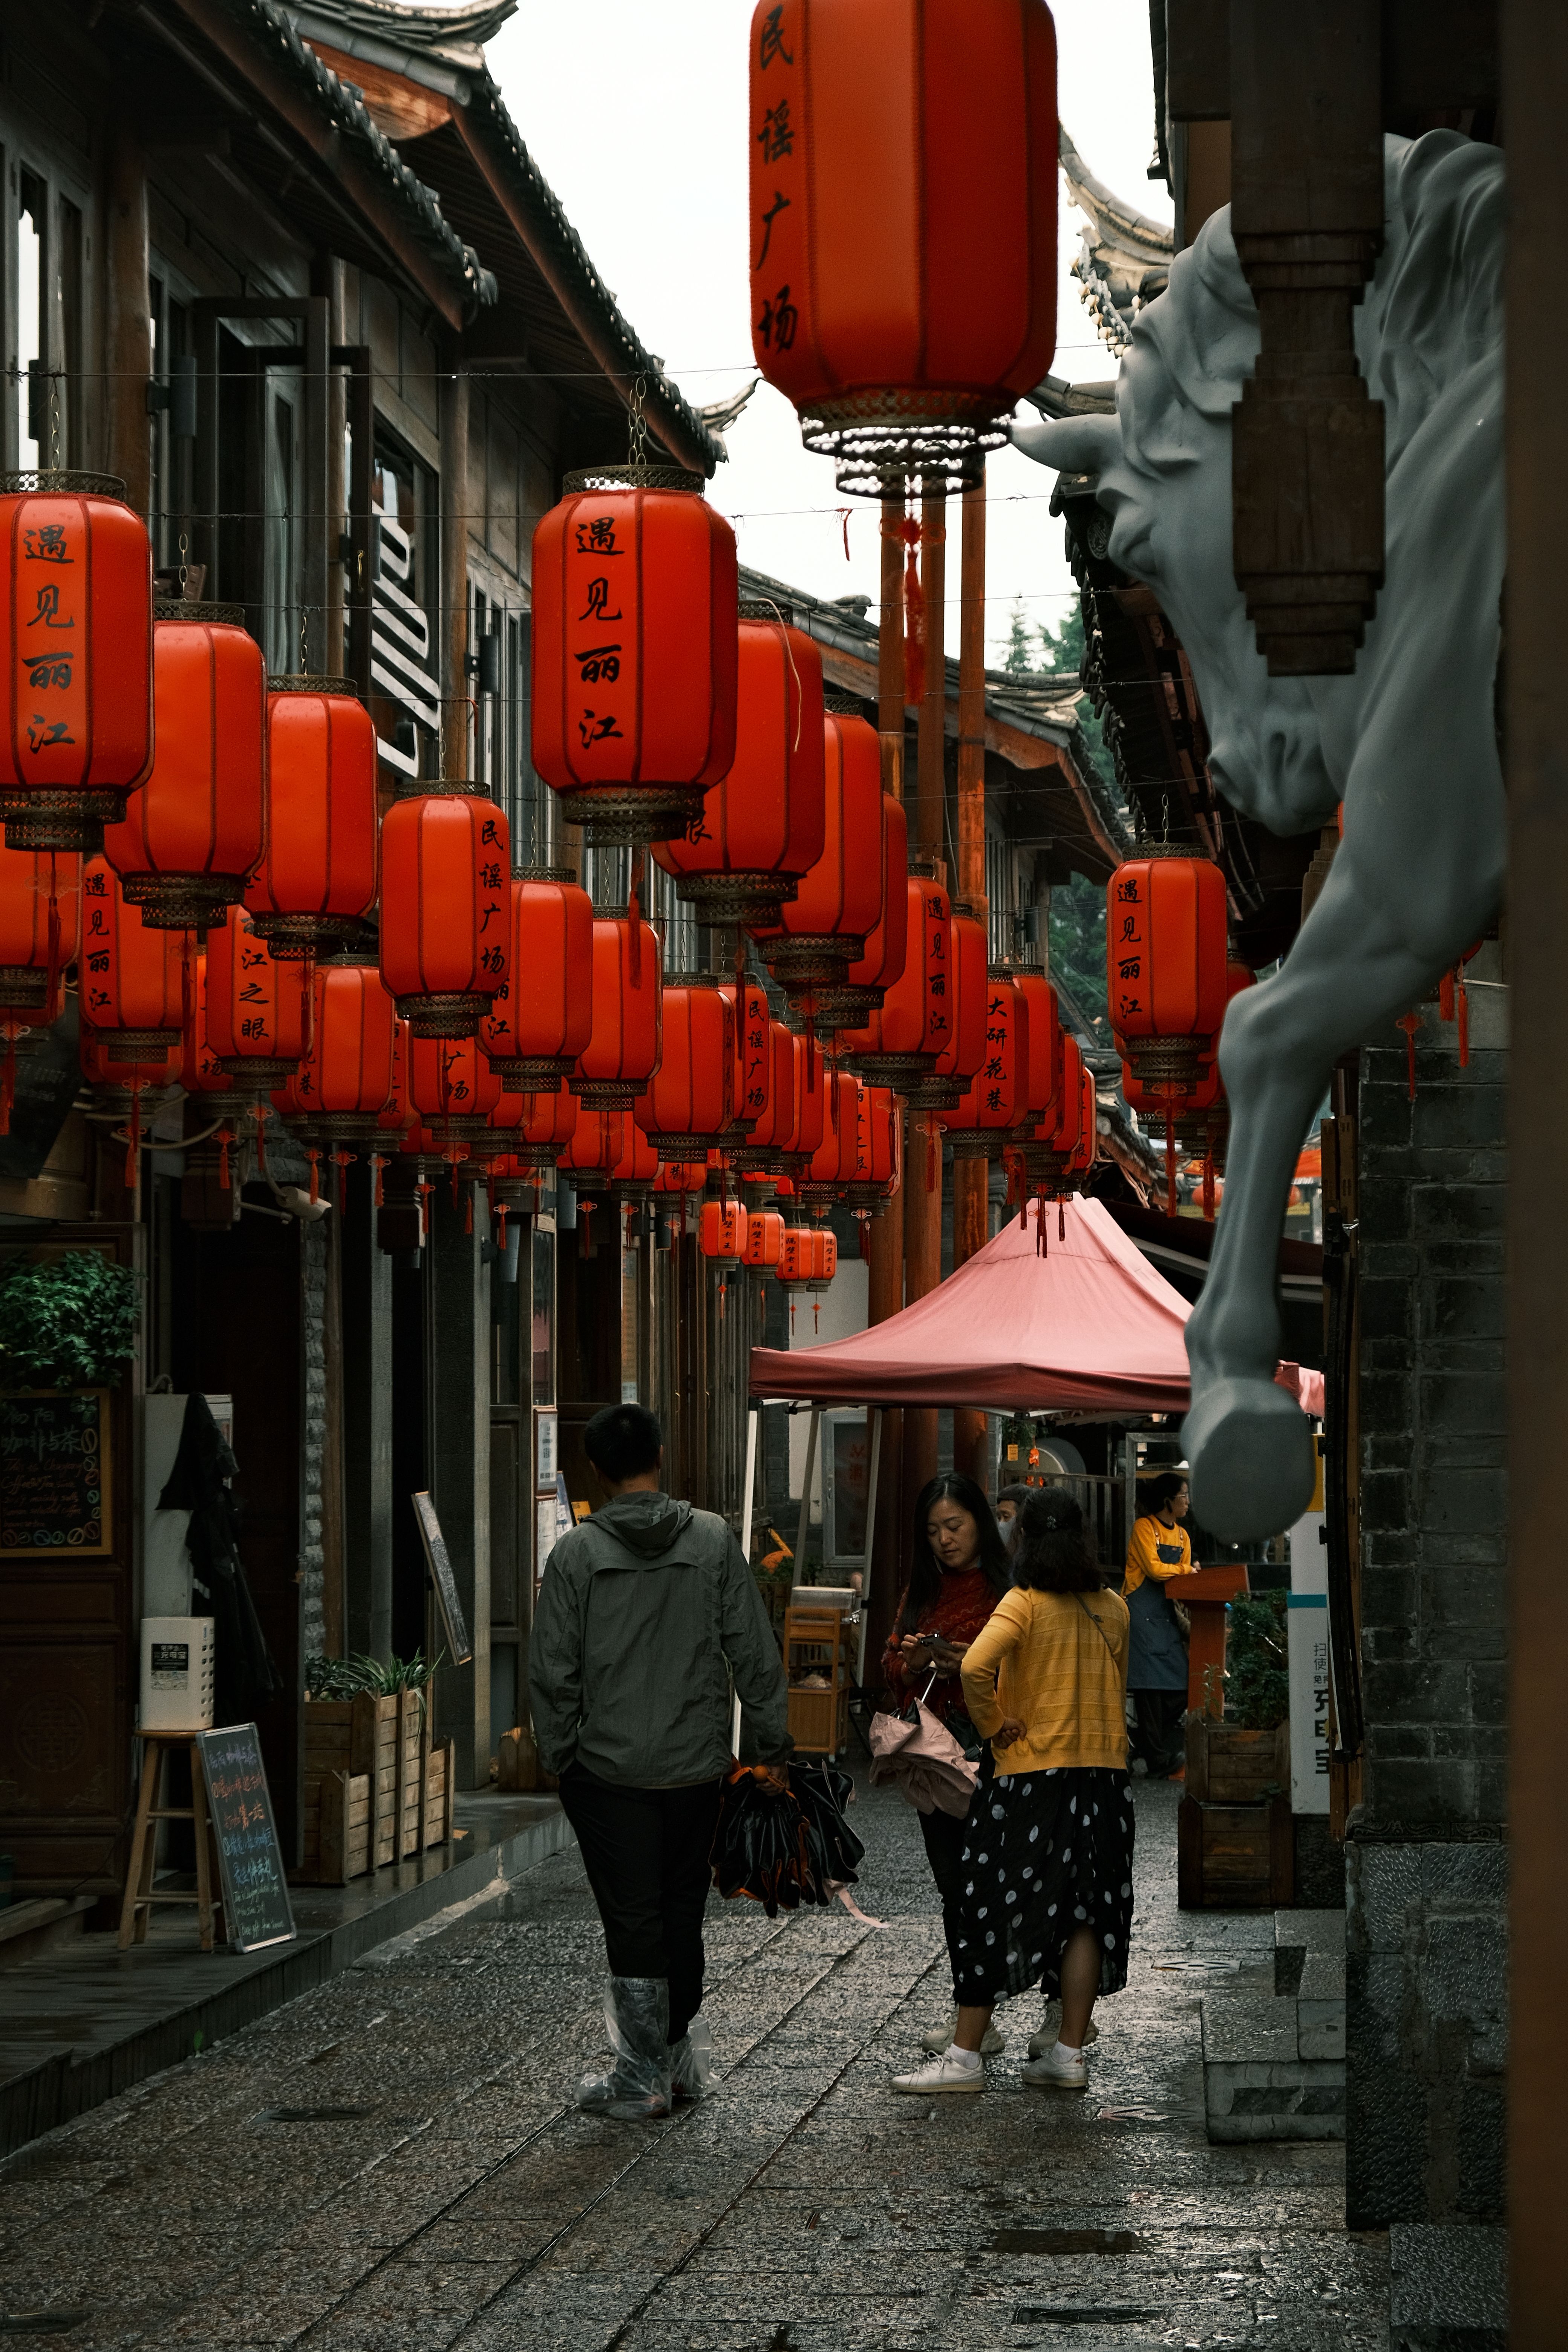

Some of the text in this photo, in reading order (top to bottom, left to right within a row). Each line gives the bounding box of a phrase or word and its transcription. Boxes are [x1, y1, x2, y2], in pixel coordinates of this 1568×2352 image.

[756, 5, 798, 354] 民谣广场
[22, 524, 75, 755] 遇见丽江
[574, 516, 625, 749] 遇见丽江
[85, 873, 112, 1012] 遇见丽江
[479, 819, 505, 974] 民谣广场
[927, 896, 948, 1035] 遇见丽江
[1117, 879, 1143, 1019] 遇见丽江
[747, 1000, 765, 1107] 民谣广场
[983, 997, 1008, 1112] 大研花巷
[750, 1221, 763, 1258] 隔壁老王
[785, 1237, 796, 1272] 隔壁老王
[825, 1238, 835, 1272] 隔壁老王
